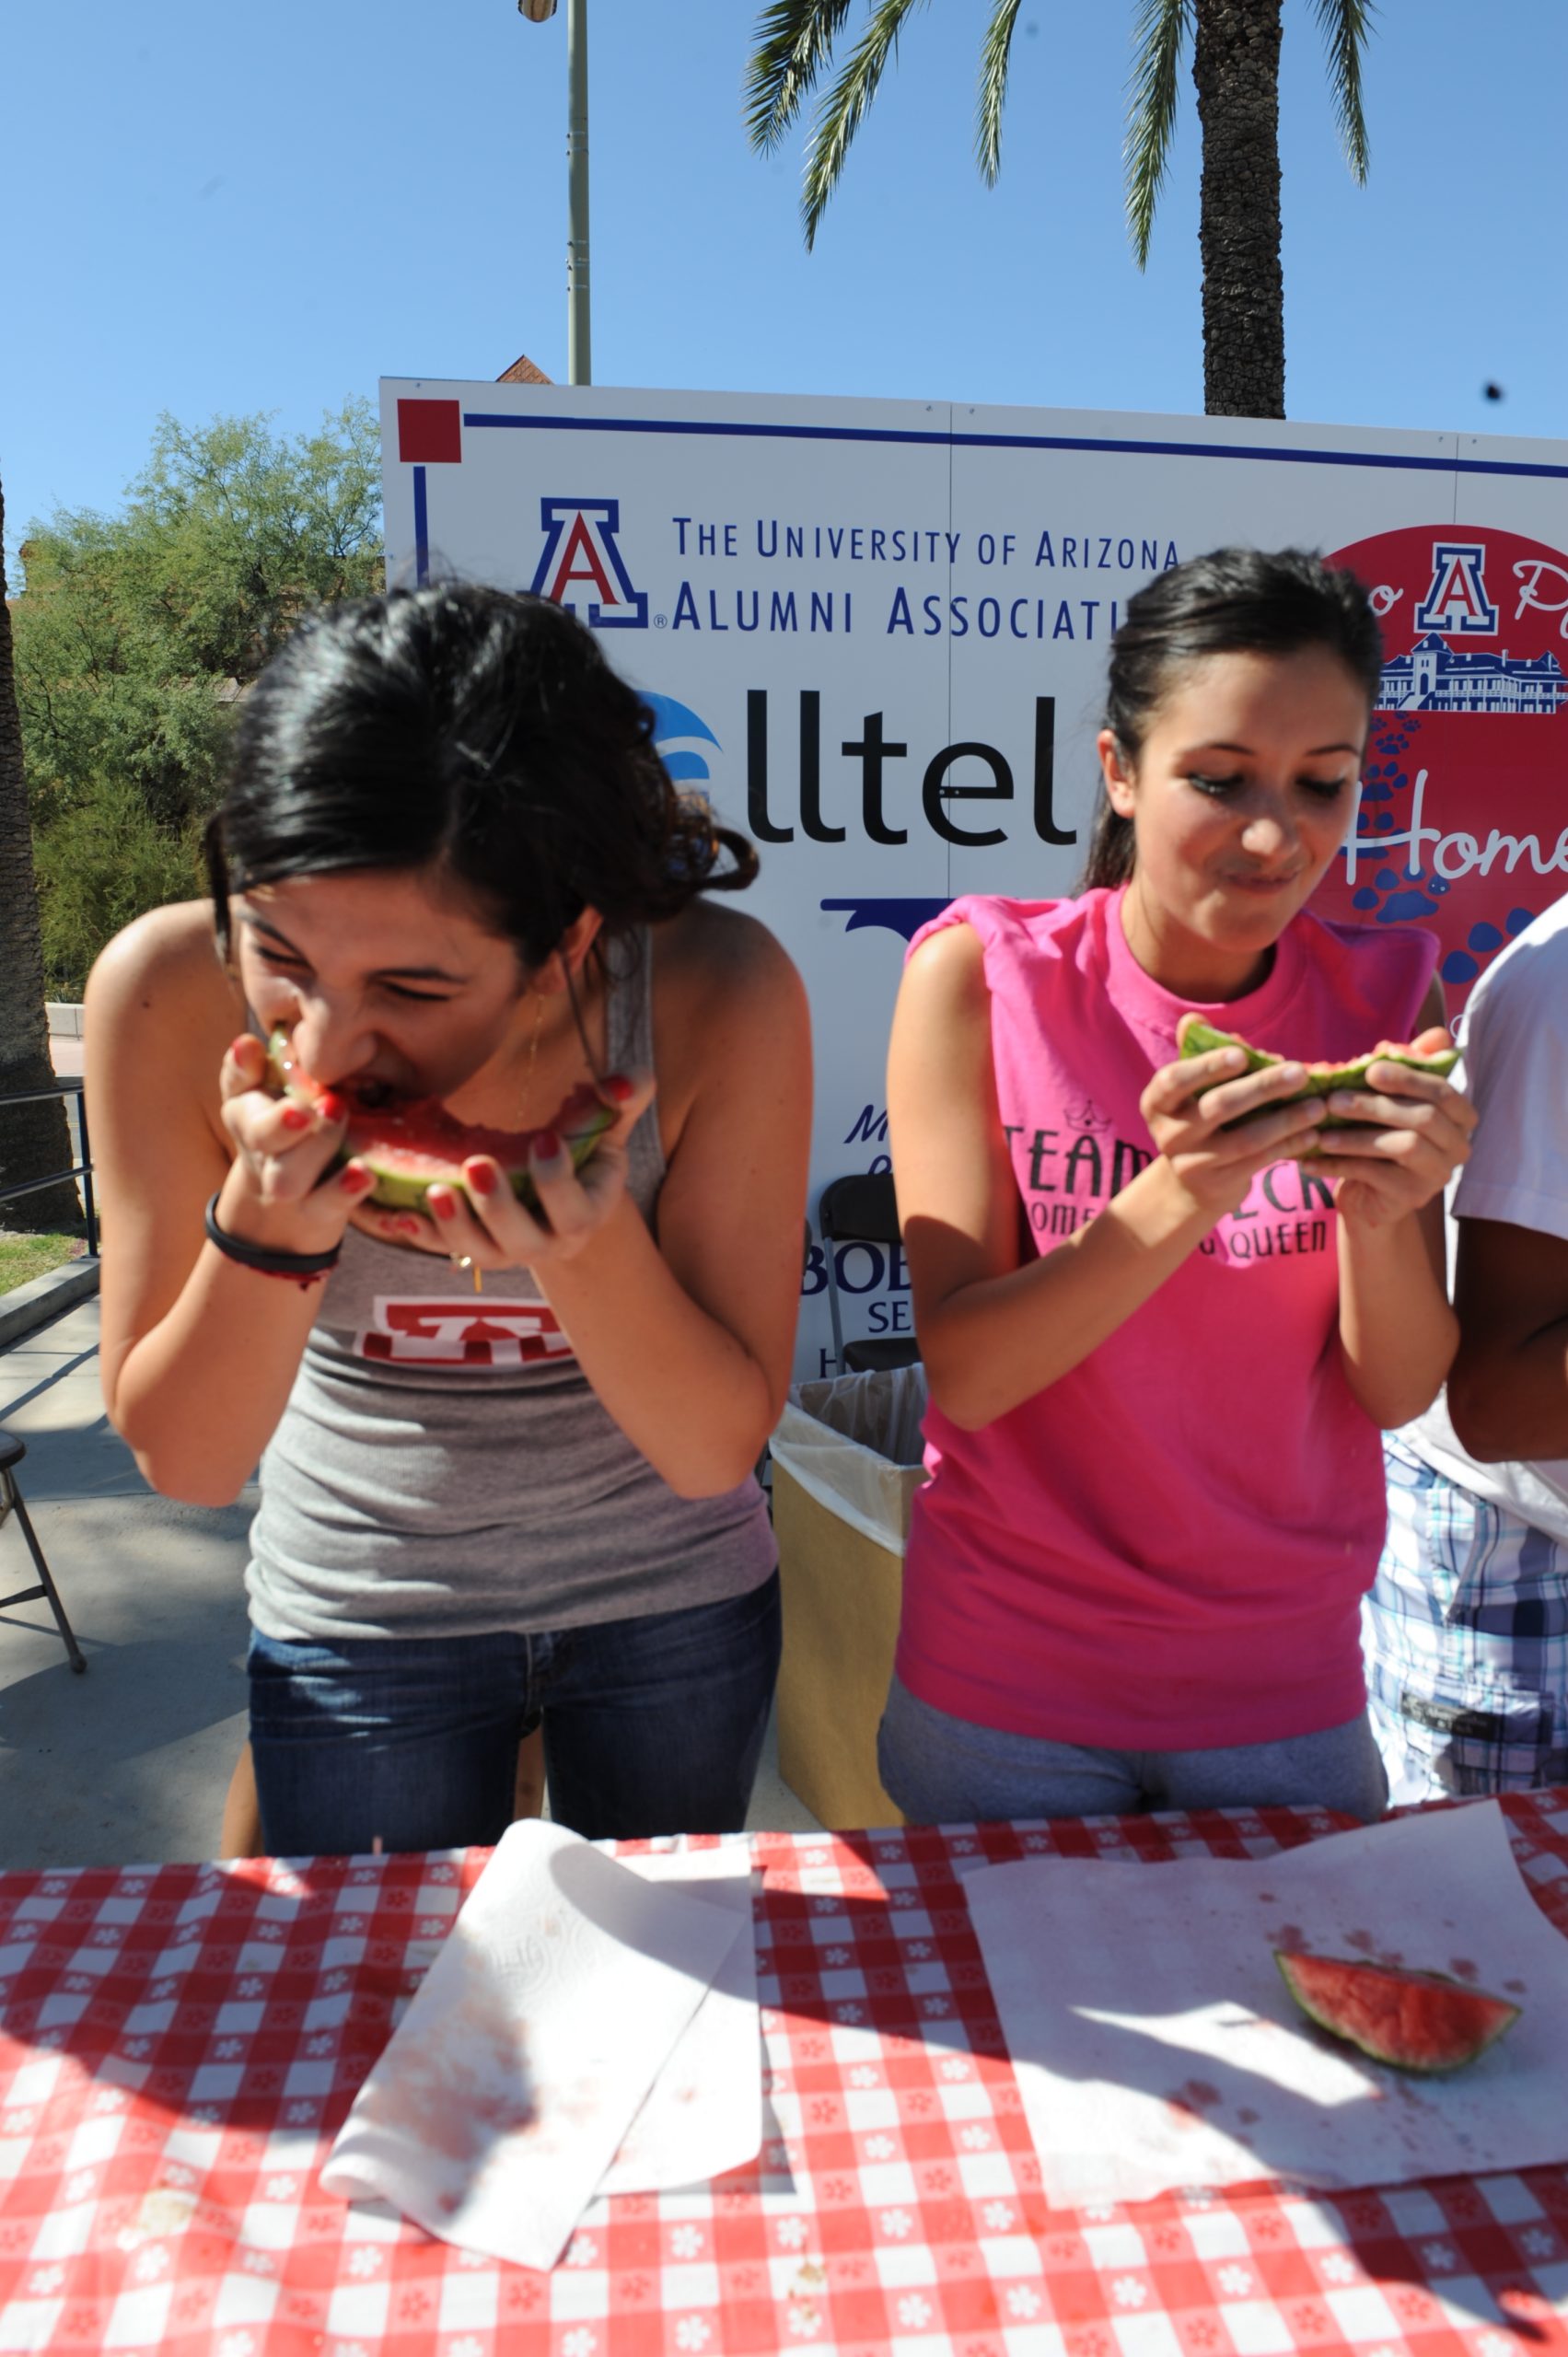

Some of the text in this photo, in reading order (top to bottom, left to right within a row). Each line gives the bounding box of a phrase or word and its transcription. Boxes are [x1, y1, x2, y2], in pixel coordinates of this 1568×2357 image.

[672, 517, 1179, 571] THE UNIVERSITY OF ARIZONA
[672, 581, 851, 633] ALUMNI
[1229, 1220, 1327, 1260] QUEEN
